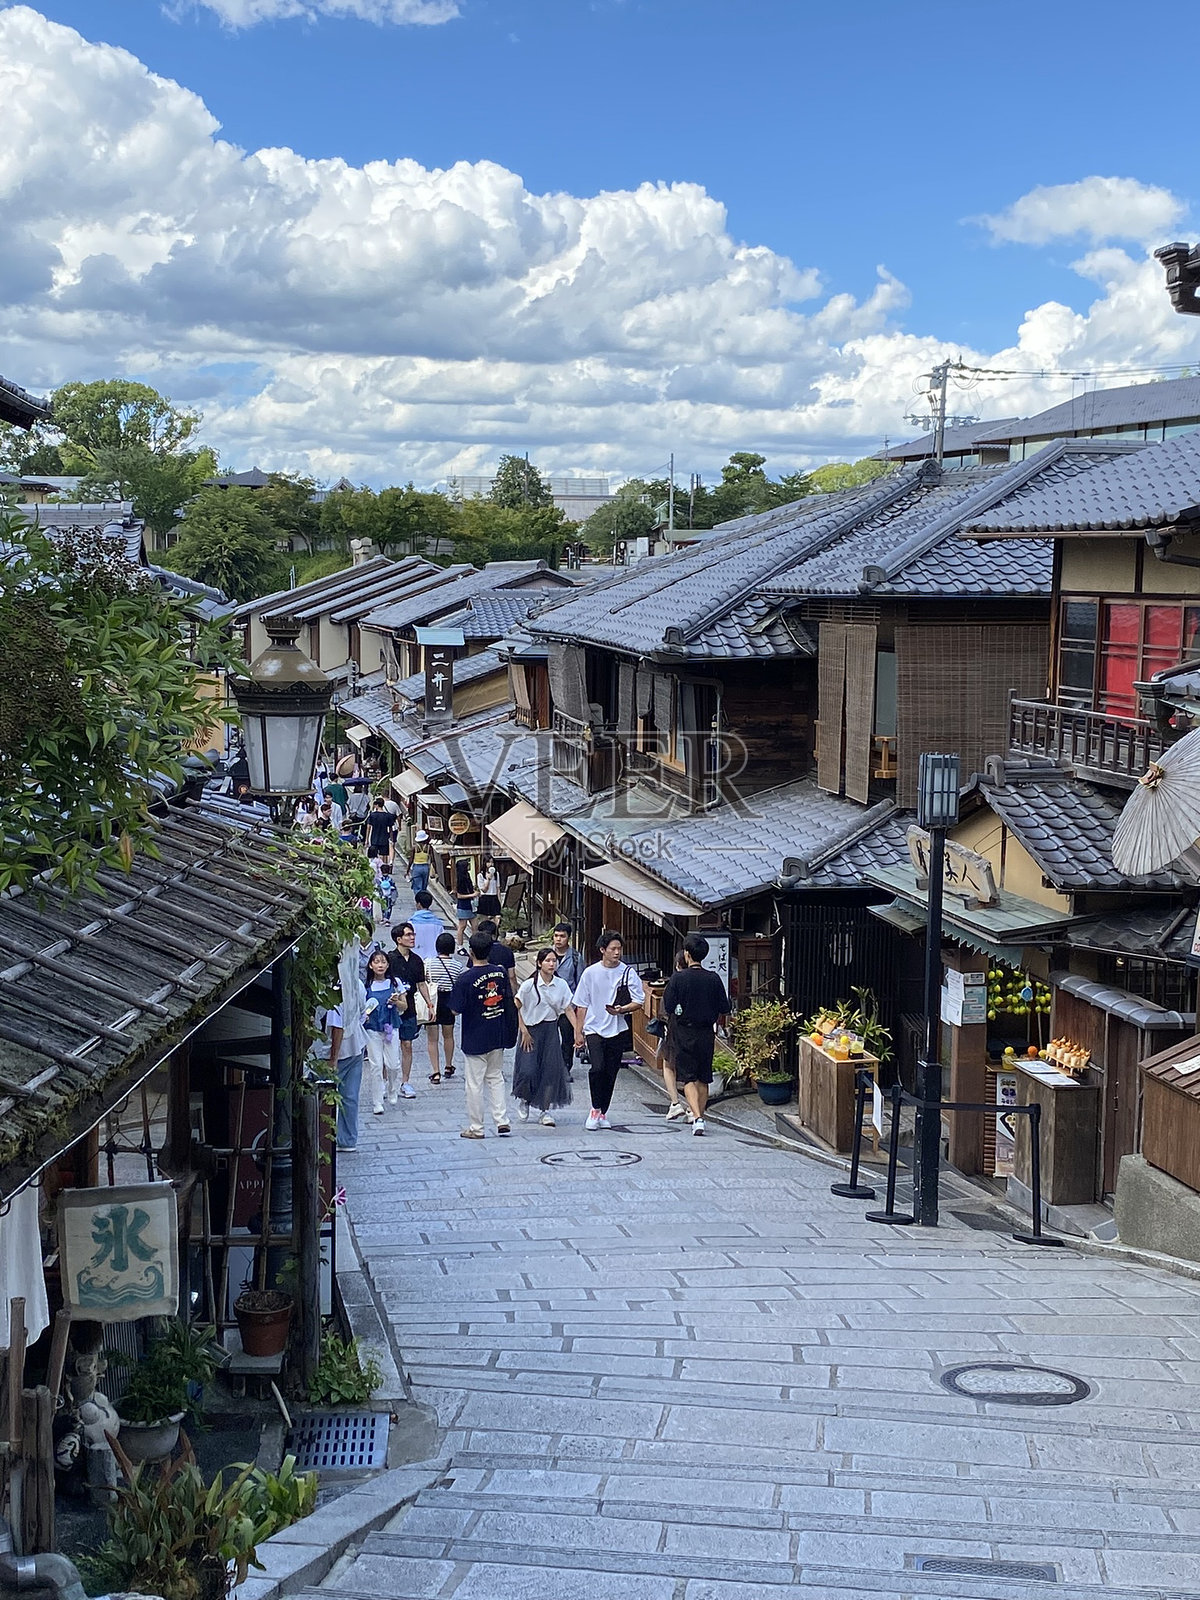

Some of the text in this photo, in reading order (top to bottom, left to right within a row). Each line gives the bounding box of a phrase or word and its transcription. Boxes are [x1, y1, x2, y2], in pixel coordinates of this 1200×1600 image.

[431, 652, 450, 711] 二井三
[90, 1206, 159, 1273] 氷
